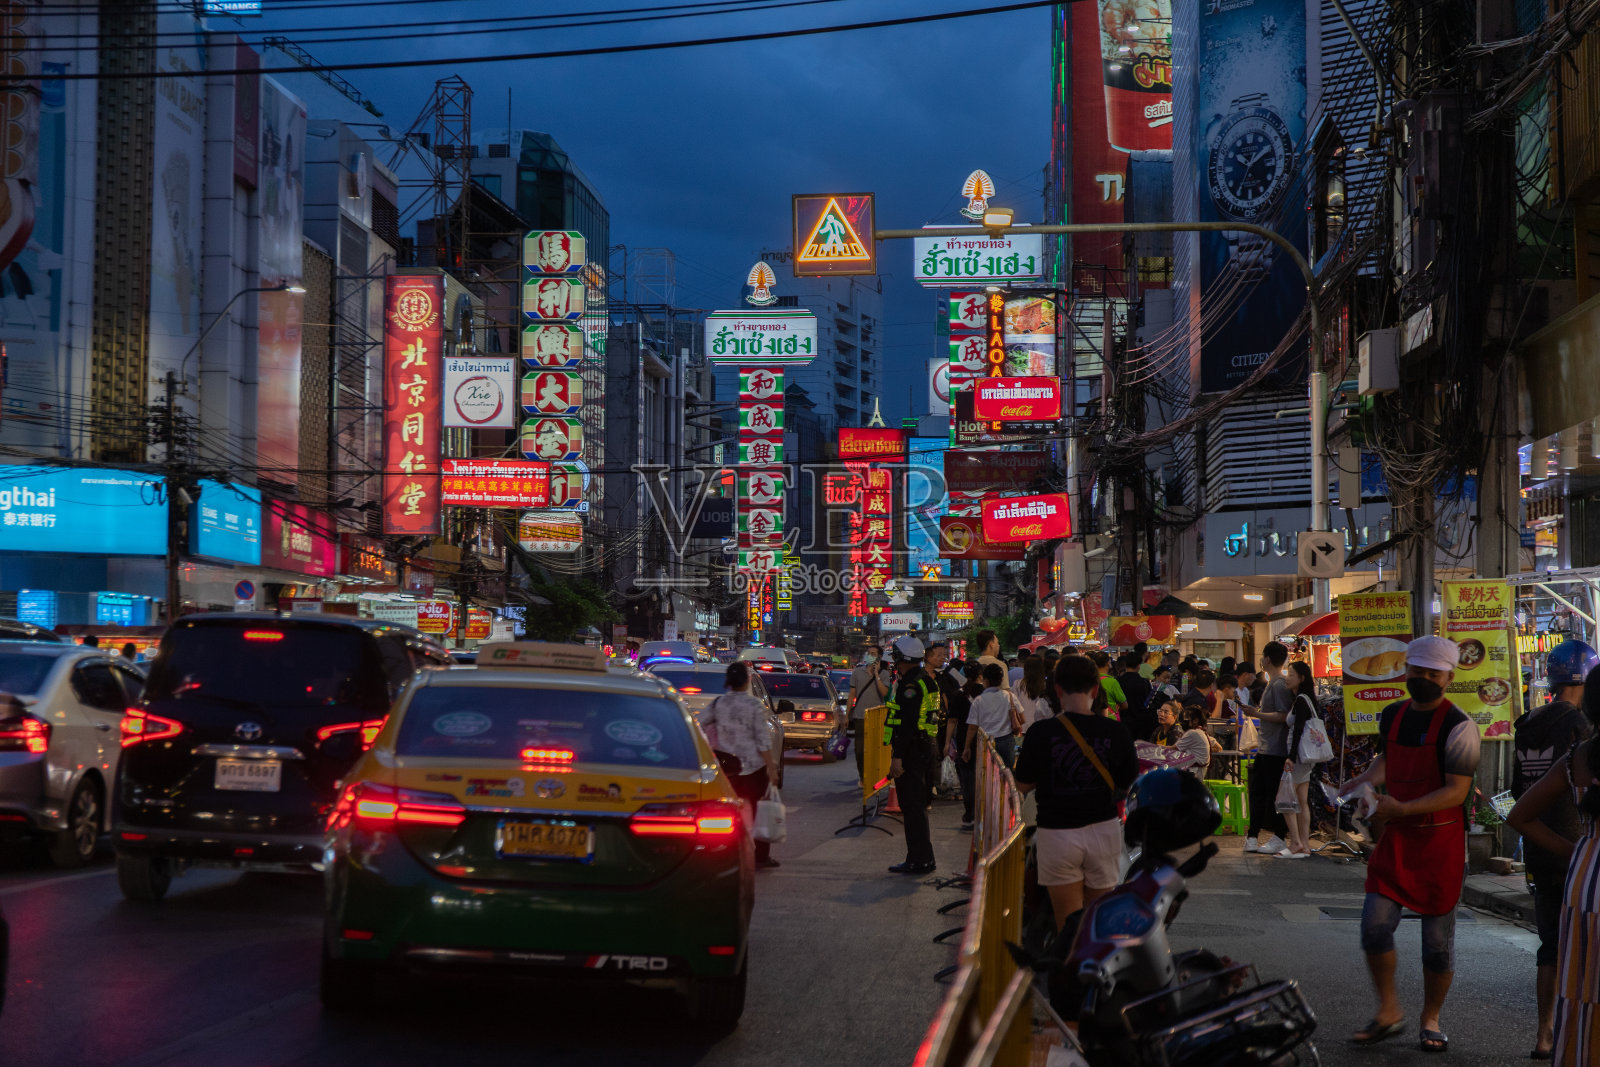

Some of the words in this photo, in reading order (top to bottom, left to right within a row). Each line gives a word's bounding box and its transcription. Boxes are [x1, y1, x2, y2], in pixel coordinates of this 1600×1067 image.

[207, 3, 258, 11] EXCHANGE
[467, 385, 491, 400] Xie
[399, 337, 428, 516] 北京同仁堂
[959, 421, 988, 432] Hote
[702, 511, 730, 523] UOB
[520, 525, 580, 539] EXCHANGE
[1343, 625, 1362, 634] Mango
[1364, 625, 1376, 633] with
[1378, 624, 1395, 632] Sticky
[1397, 623, 1409, 631] Rice
[1516, 635, 1538, 652] MANGO
[1379, 690, 1393, 698] 100
[1350, 712, 1373, 722] Like
[611, 955, 668, 971] TRD
